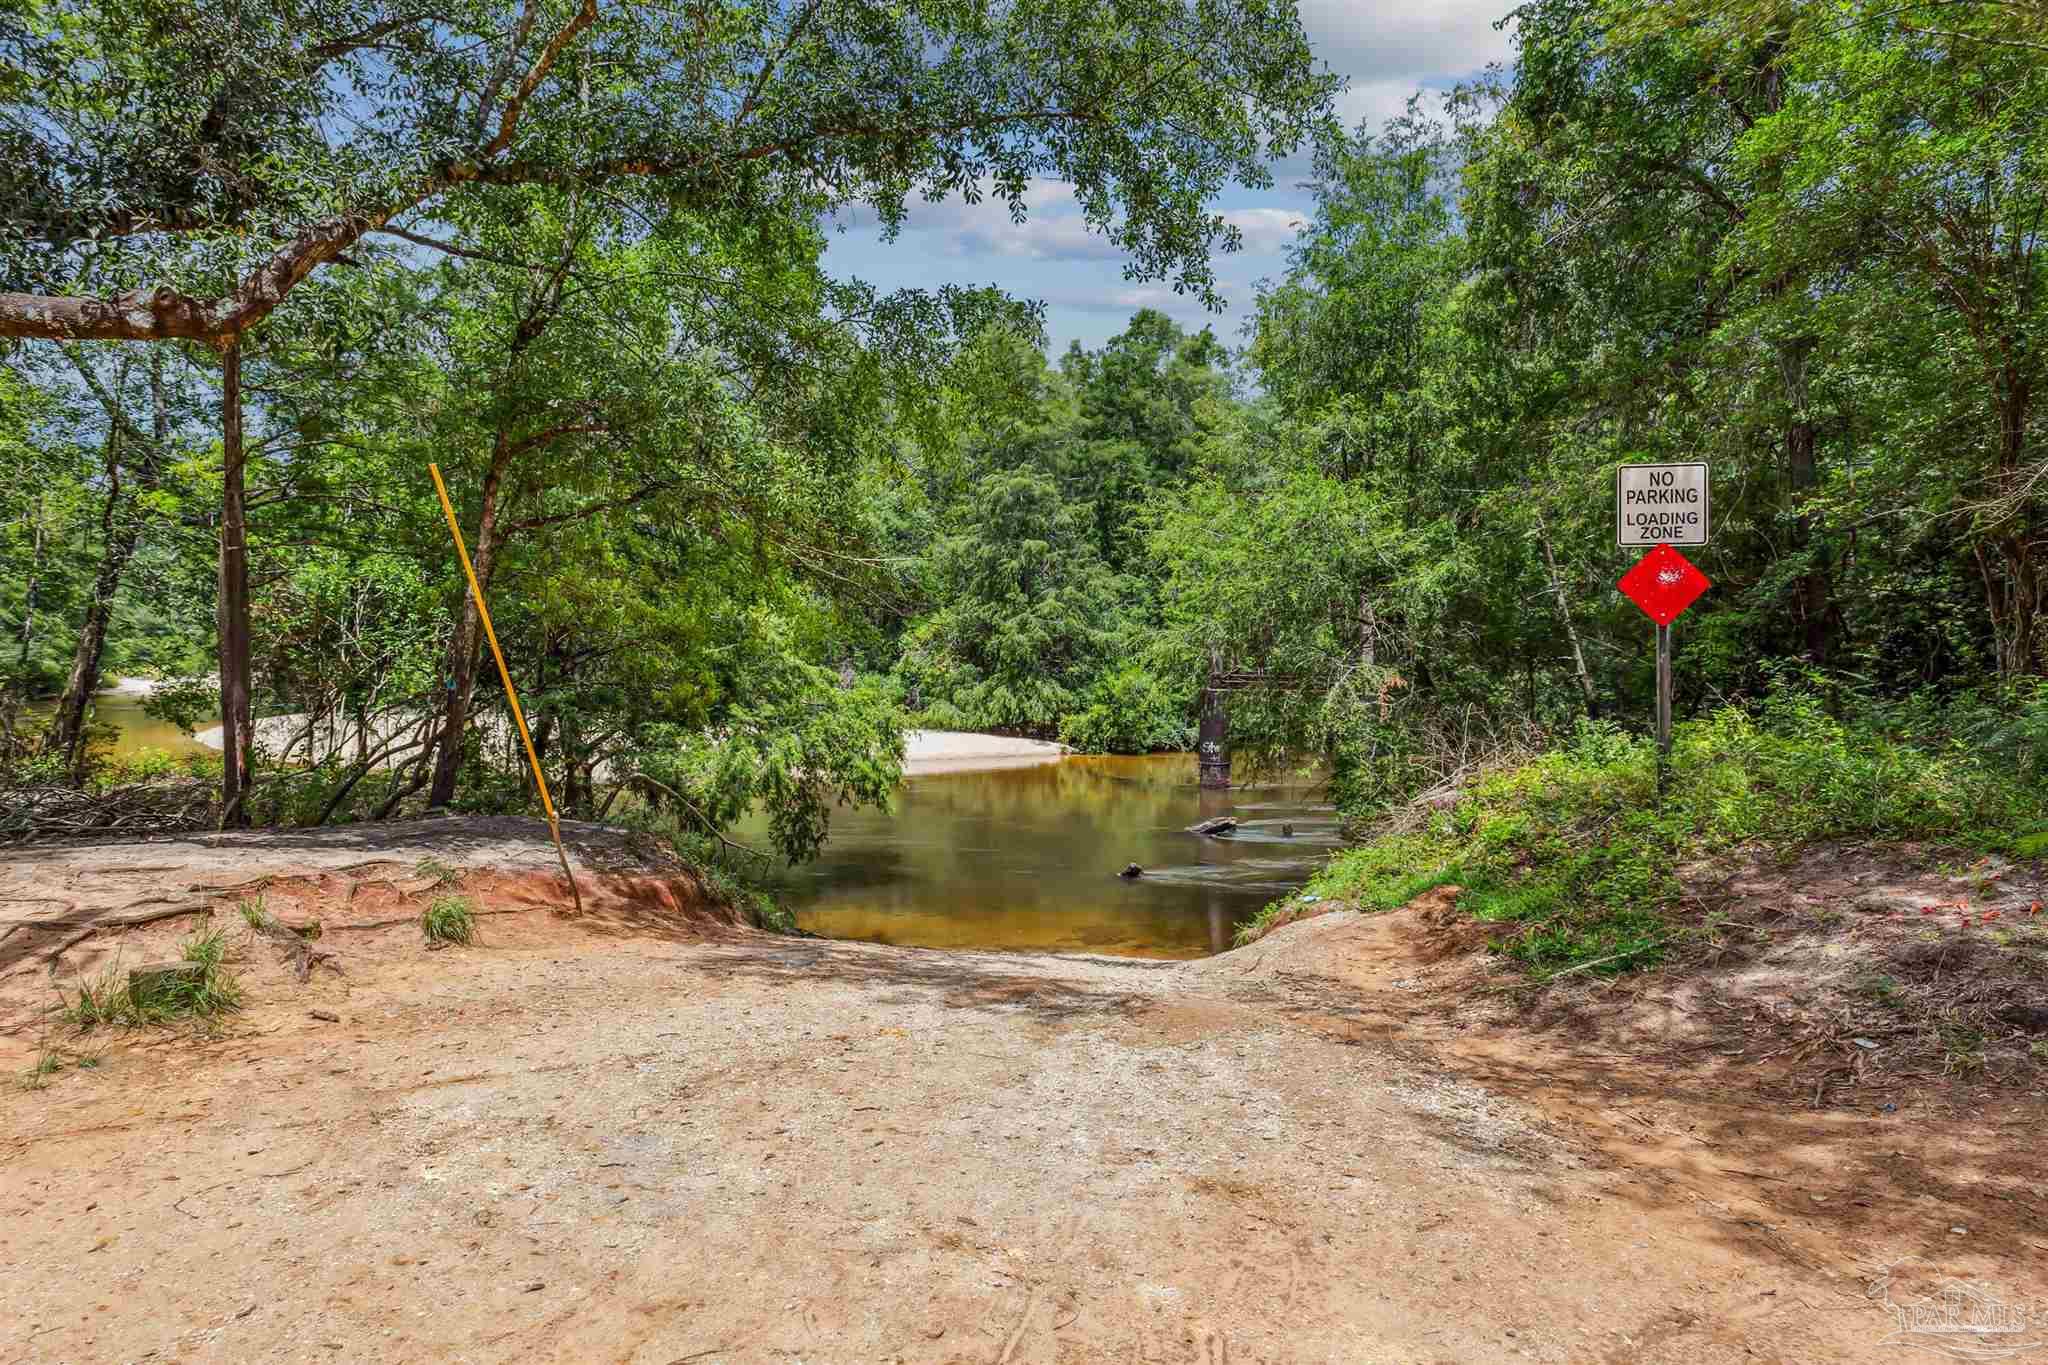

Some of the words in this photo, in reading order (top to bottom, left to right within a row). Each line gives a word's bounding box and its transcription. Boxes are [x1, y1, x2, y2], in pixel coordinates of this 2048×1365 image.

[1650, 472, 1674, 487] NO
[1626, 488, 1698, 505] PARKING
[1627, 512, 1698, 526] LOADING
[1640, 526, 1684, 539] ZONE
